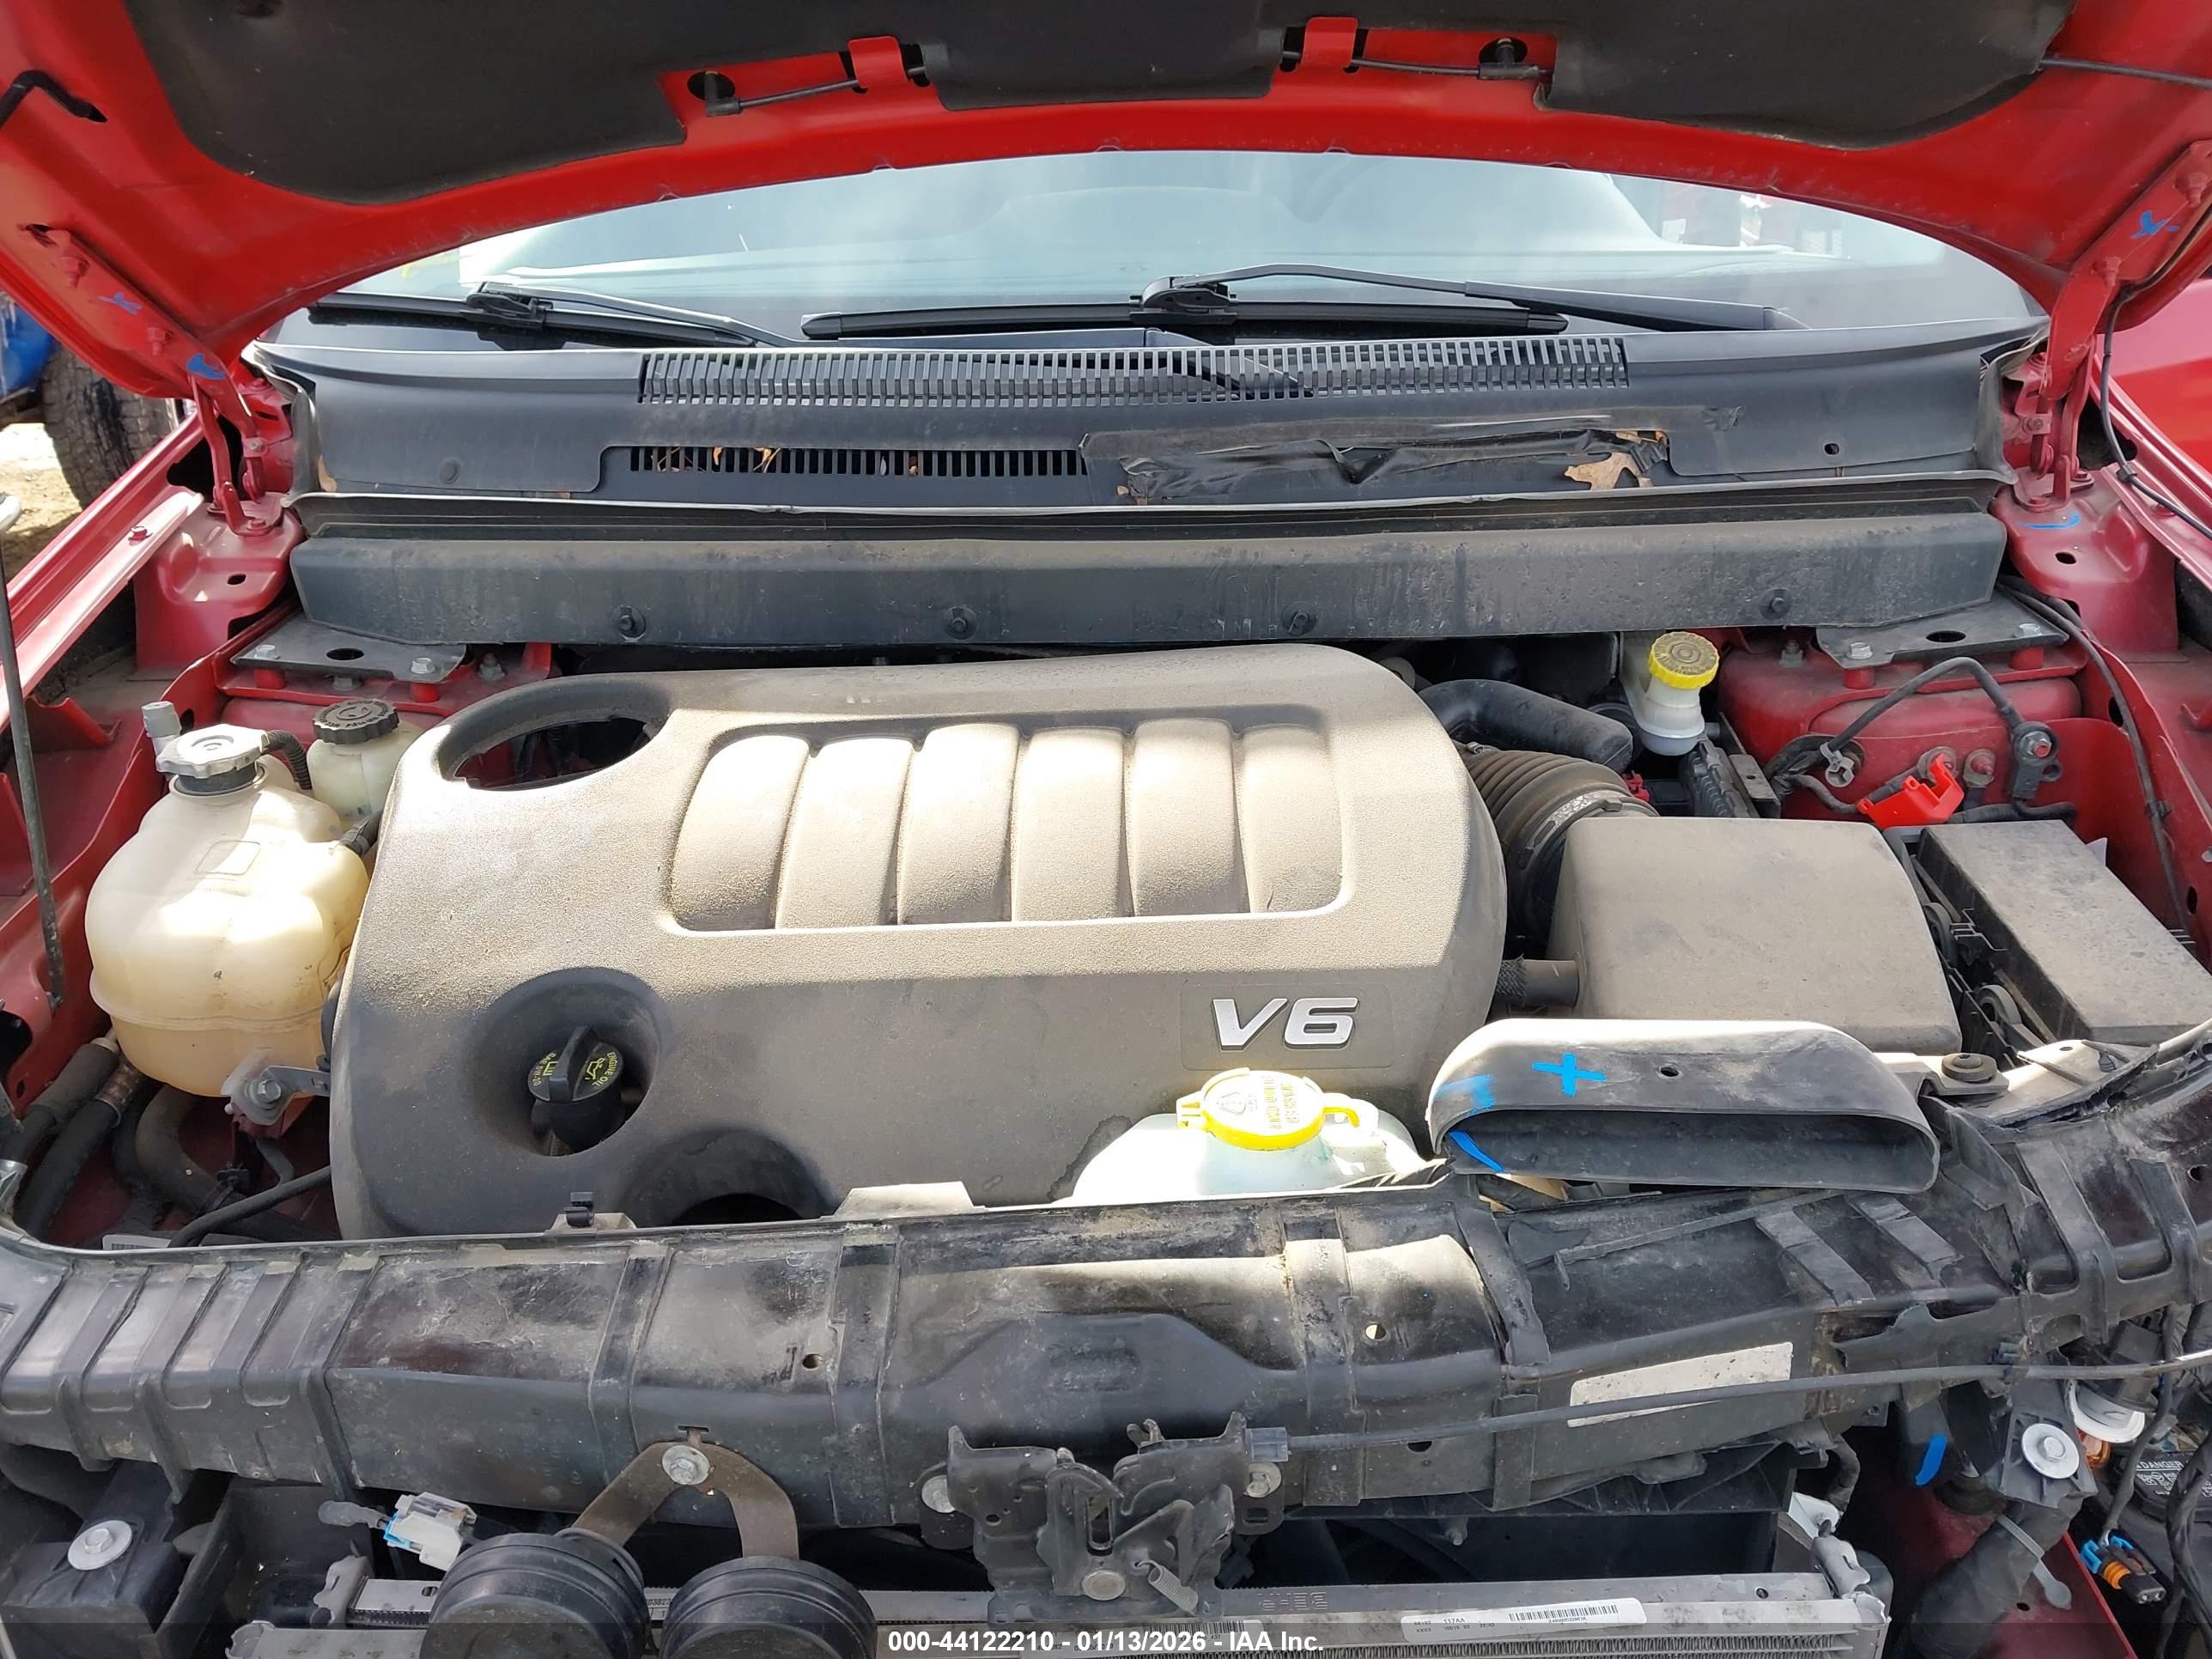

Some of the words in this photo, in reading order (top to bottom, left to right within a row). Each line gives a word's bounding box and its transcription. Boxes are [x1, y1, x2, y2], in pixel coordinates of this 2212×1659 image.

[1211, 997, 1359, 1051] V6
[605, 1051, 618, 1076] ENGINE
[592, 1076, 609, 1087] OIL
